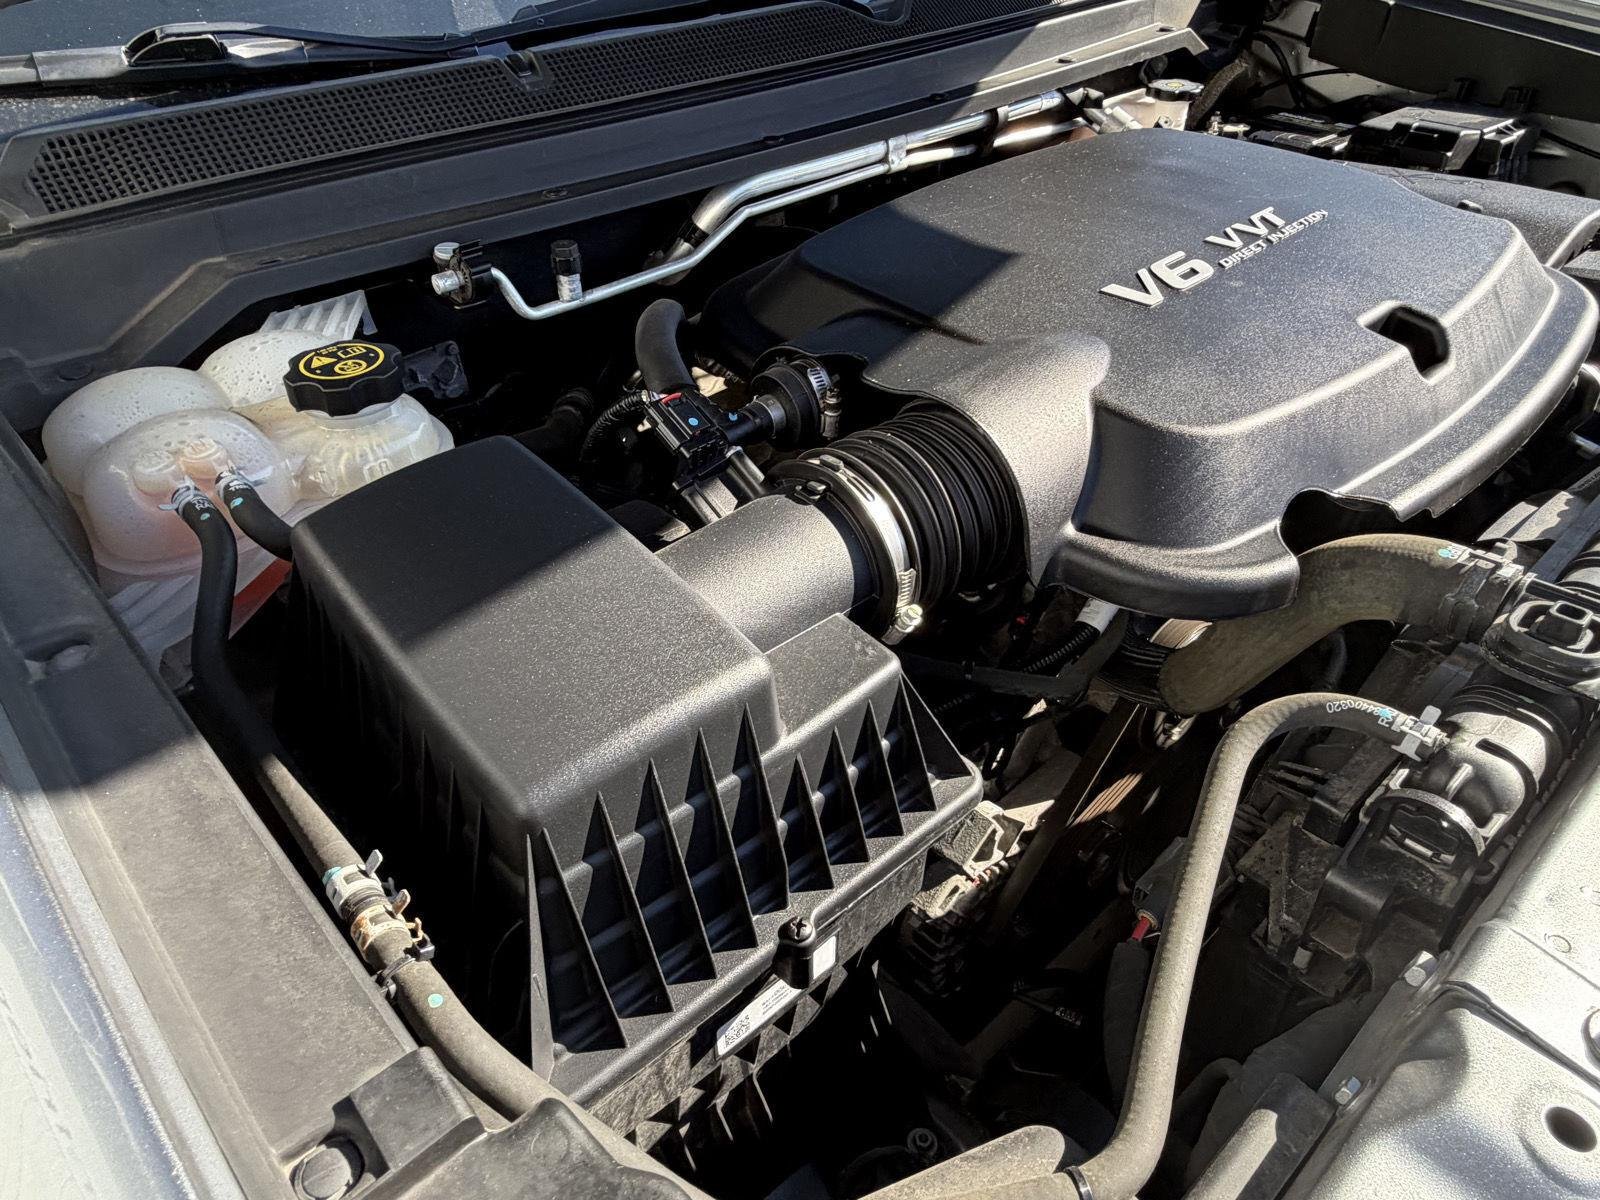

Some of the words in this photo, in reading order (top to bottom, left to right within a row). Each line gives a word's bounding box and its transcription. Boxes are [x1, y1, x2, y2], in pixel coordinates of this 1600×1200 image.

[1205, 206, 1286, 250] VVT
[1219, 240, 1267, 269] DIRECT
[1268, 209, 1329, 245] INJECTION
[1100, 250, 1215, 308] V6
